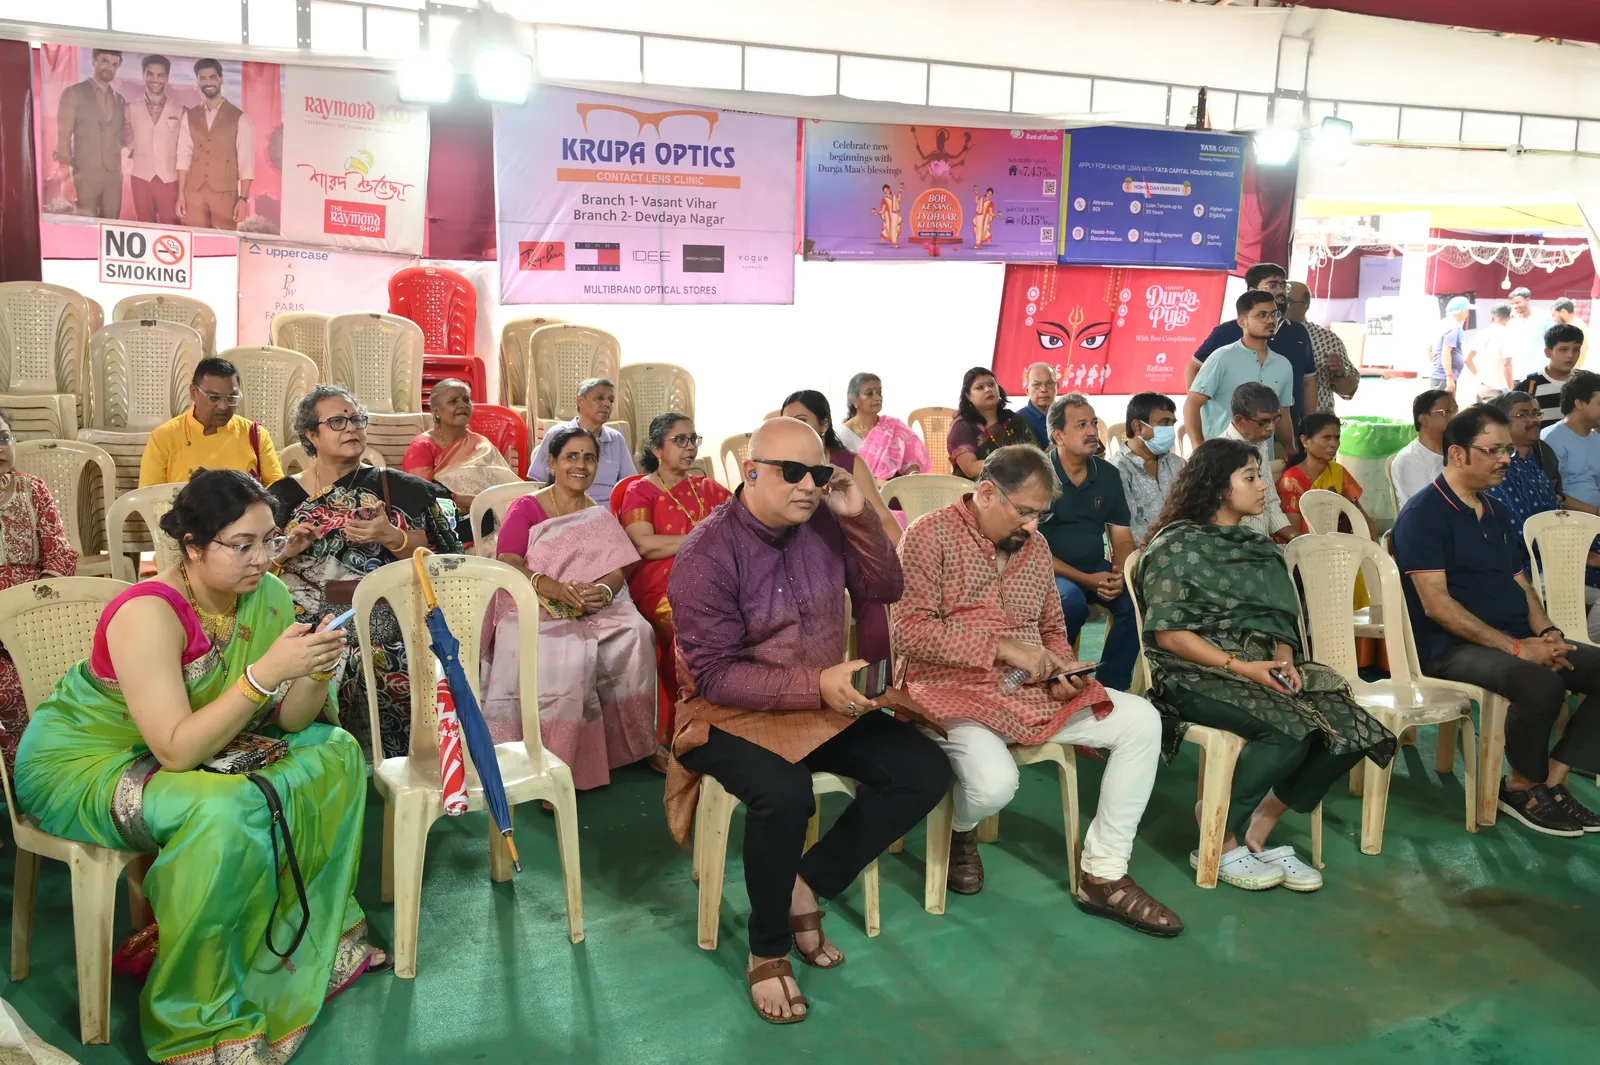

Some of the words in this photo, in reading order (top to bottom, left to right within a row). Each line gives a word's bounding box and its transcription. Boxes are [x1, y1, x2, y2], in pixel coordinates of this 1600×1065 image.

[304, 96, 375, 120] Raymond
[833, 140, 871, 150] Celebrate
[562, 138, 645, 166] KRUPA
[655, 142, 736, 168] OPTICS
[829, 152, 872, 164] beginnings
[874, 154, 892, 162] with
[818, 164, 842, 175] Durga
[867, 165, 902, 177] blessings
[597, 172, 643, 182] CONTACT
[646, 174, 671, 183] LENS
[674, 175, 704, 185] CLINIC
[582, 194, 625, 206] Branch
[642, 196, 682, 208] Vasant
[686, 198, 718, 209] Vihar
[928, 194, 947, 202] BOB
[330, 211, 380, 227] Raymond
[574, 209, 617, 221] Branch
[635, 212, 686, 226] Devdaya
[690, 213, 725, 227] Nagar
[917, 213, 957, 221] TYOHAAR
[360, 225, 380, 233] SHOP
[105, 230, 147, 259] NO
[266, 247, 329, 261] uppercase
[632, 250, 671, 262] IDEE
[738, 254, 769, 263] vogue
[105, 263, 187, 283] SMOKING
[584, 285, 642, 294] MULTIBRAND
[644, 286, 680, 295] OPTICAL
[683, 286, 717, 295] STORES
[1146, 284, 1200, 312] Durga
[275, 302, 304, 311] PARIS
[1149, 305, 1190, 331] Puja
[1146, 364, 1175, 372] Reliance
